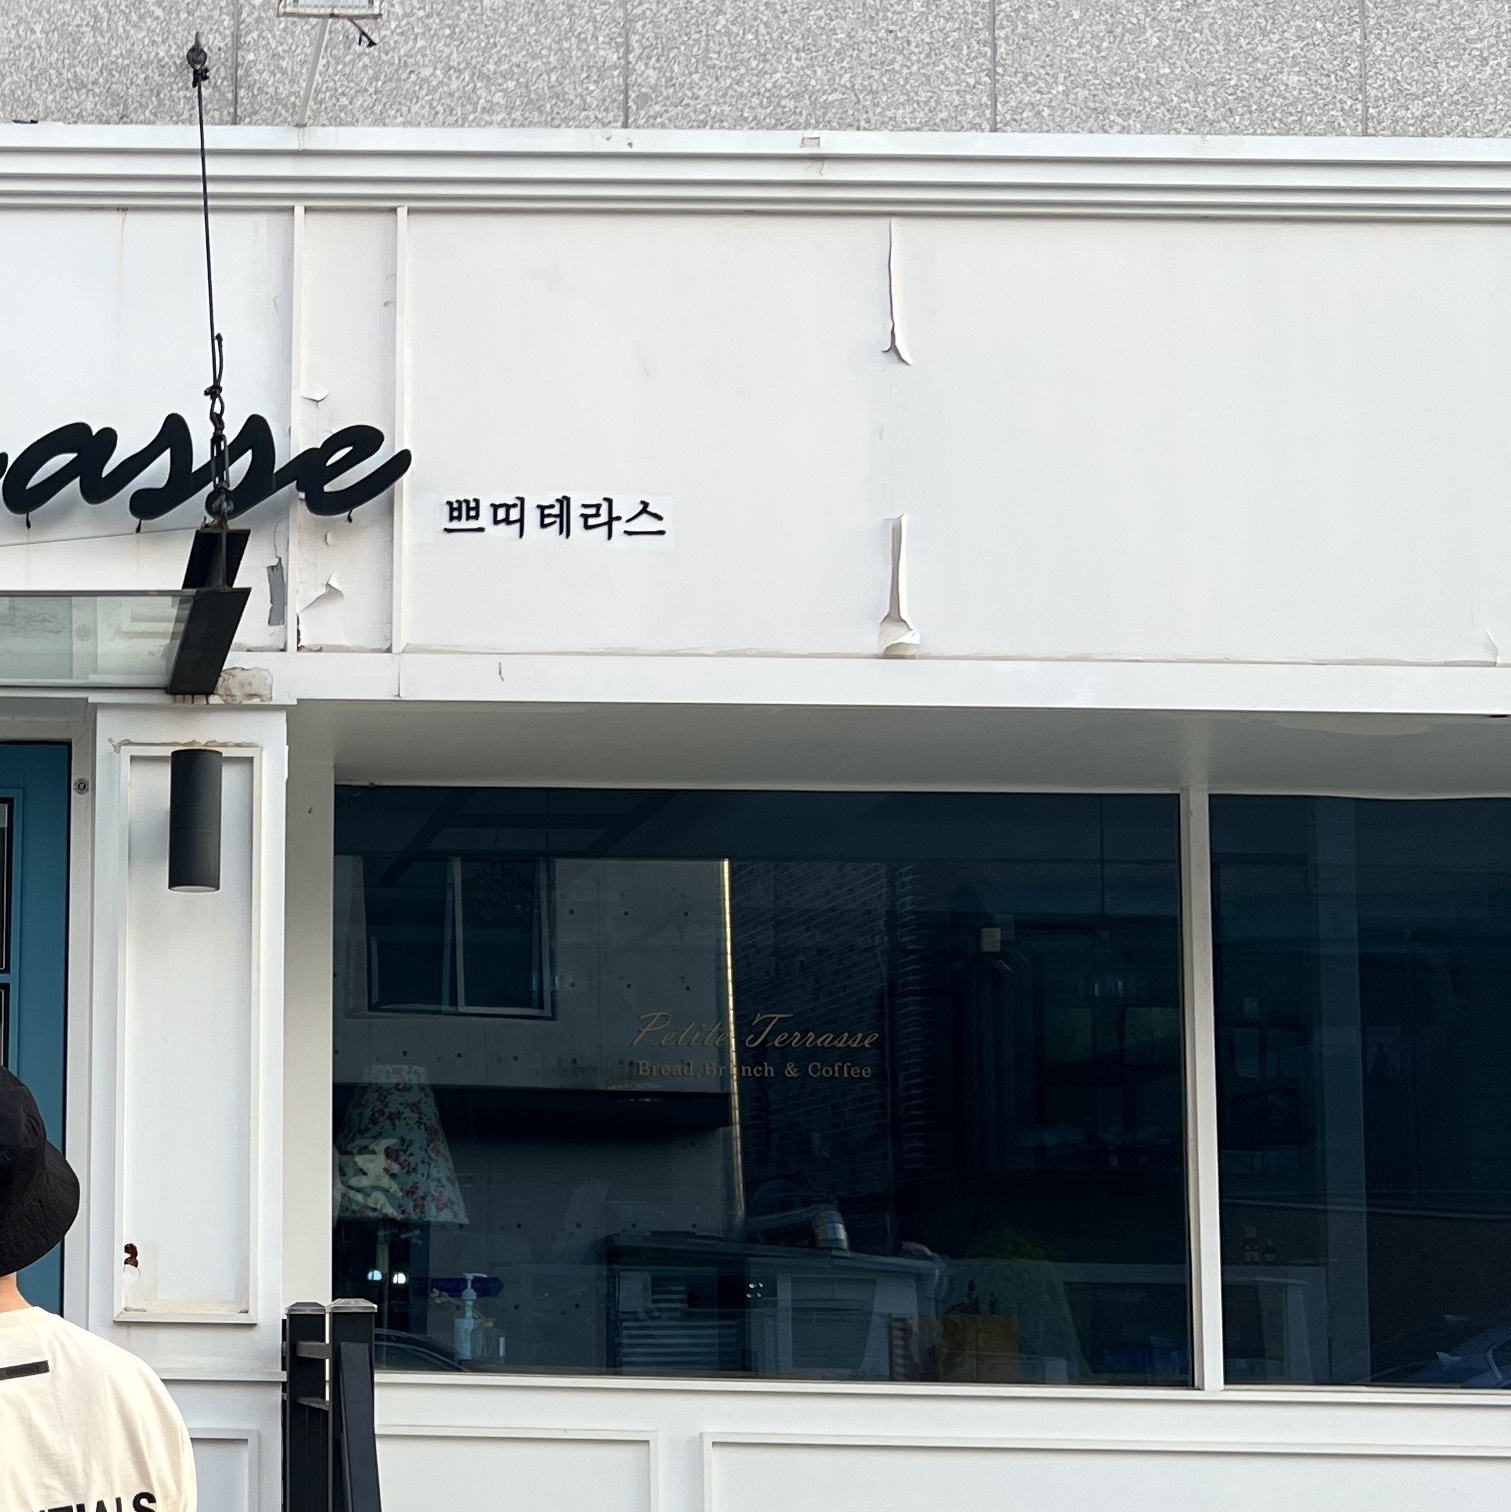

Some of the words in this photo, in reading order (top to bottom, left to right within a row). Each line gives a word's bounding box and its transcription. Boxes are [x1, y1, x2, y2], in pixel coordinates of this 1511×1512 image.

[443, 495, 666, 541] 쁘띠테라스
[631, 1012, 731, 1047] Petite
[745, 1012, 879, 1048] Terrasse
[784, 1061, 800, 1078] &
[808, 1061, 872, 1079] Coffee
